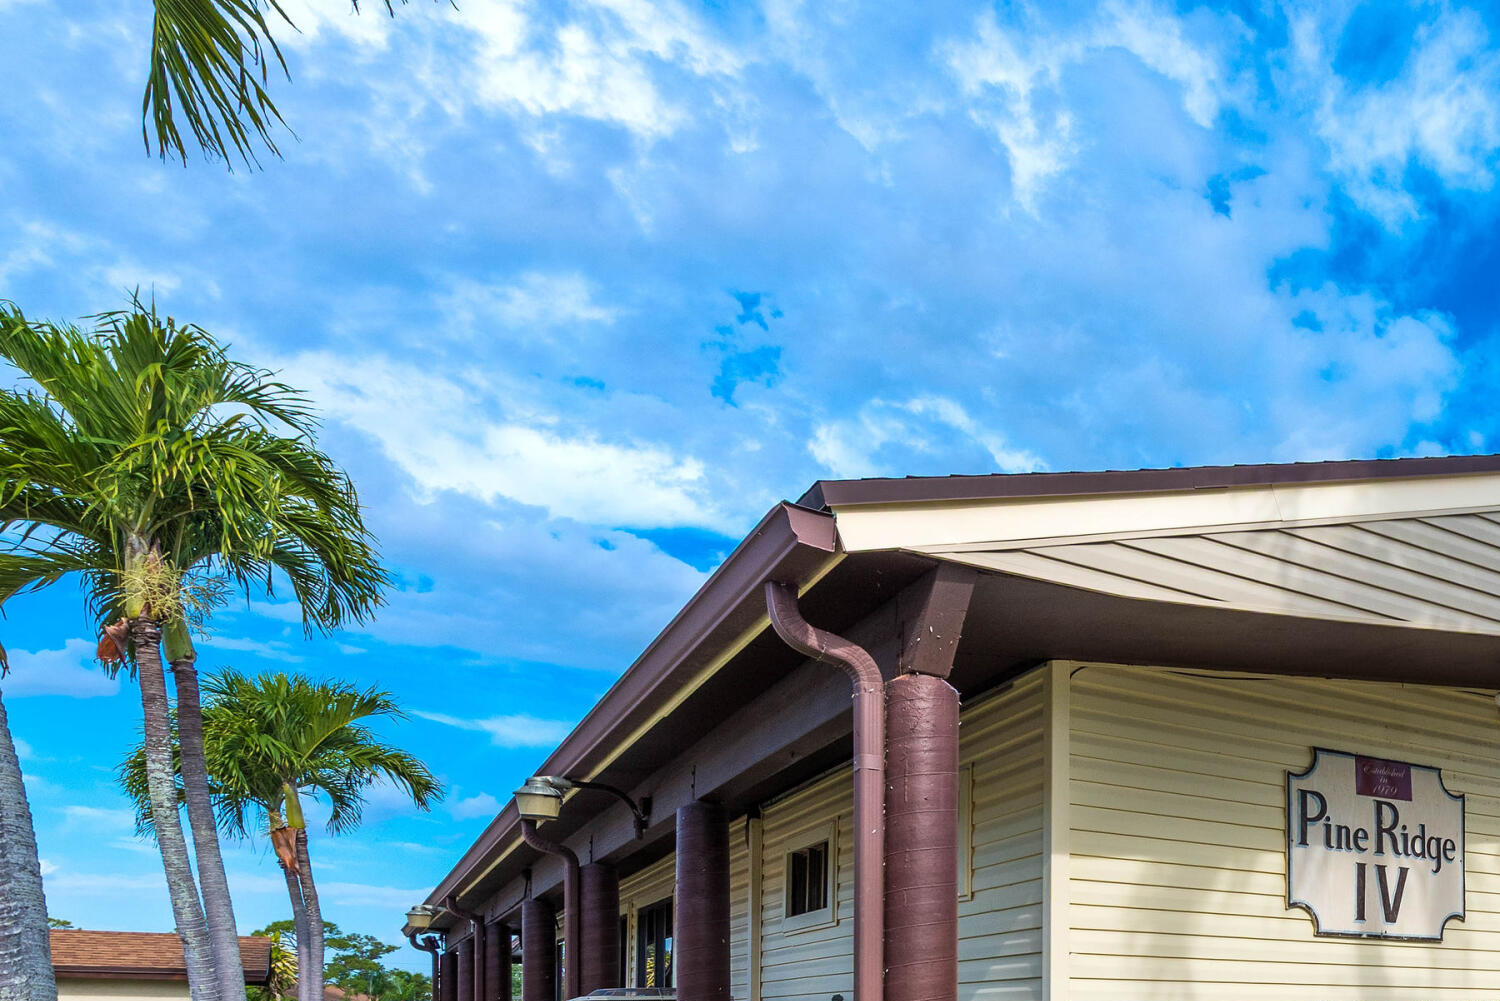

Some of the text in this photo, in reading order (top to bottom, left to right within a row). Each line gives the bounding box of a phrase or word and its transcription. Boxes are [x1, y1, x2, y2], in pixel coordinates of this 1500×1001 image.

[1372, 784, 1398, 796] 1979
[1297, 788, 1457, 874] Pine Ridge
[1354, 861, 1410, 924] IV
